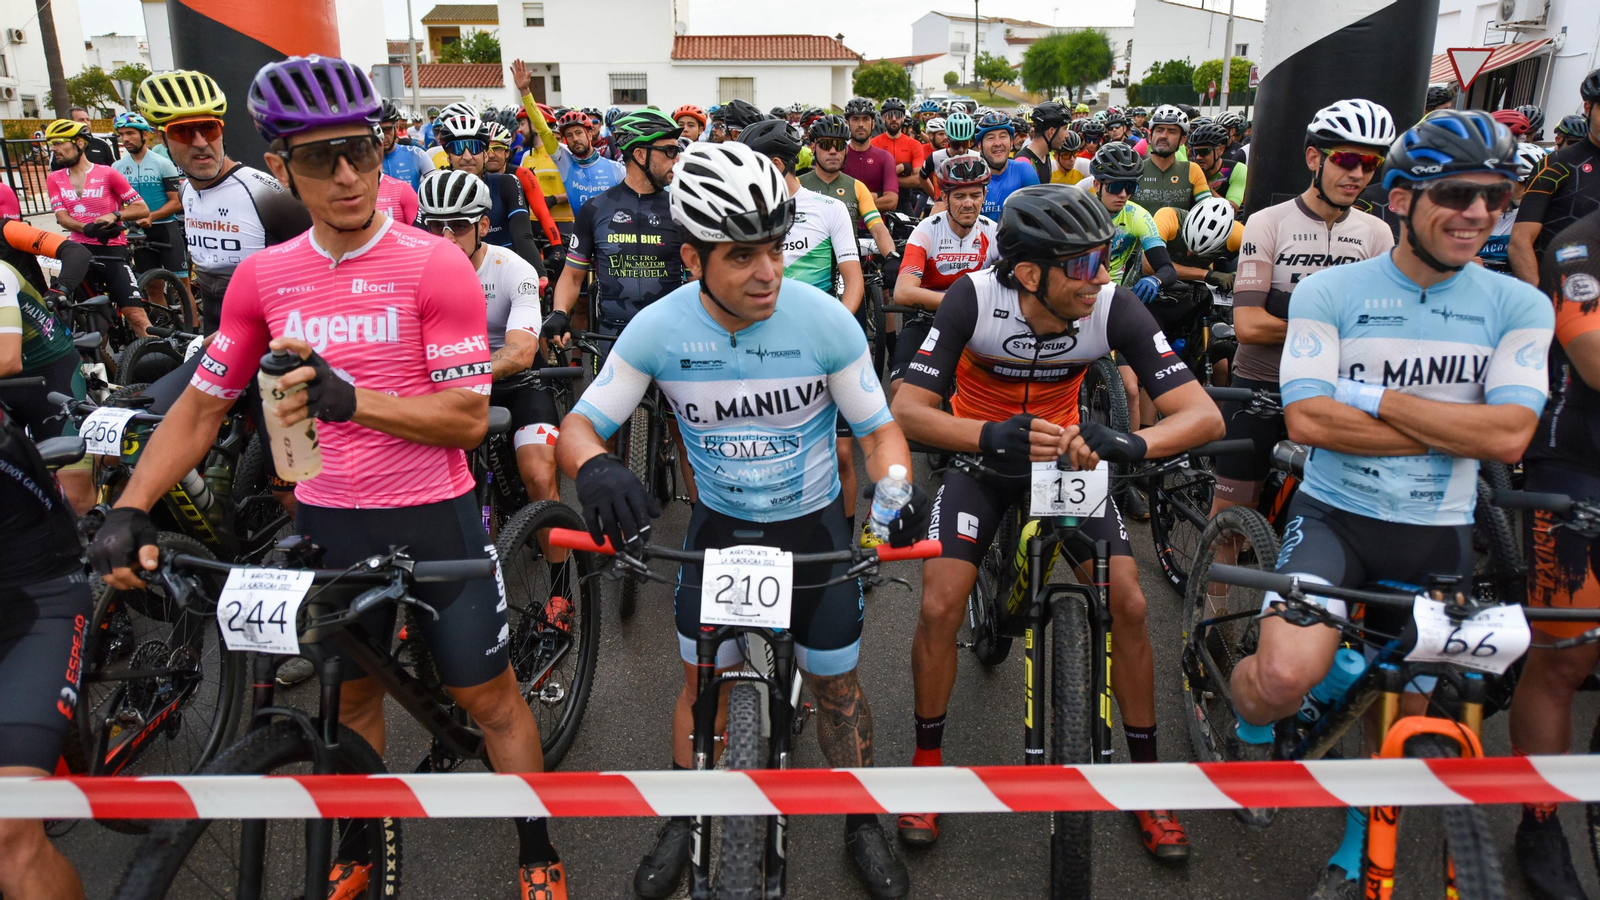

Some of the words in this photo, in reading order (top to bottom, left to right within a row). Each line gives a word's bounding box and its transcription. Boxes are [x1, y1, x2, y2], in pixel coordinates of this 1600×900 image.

[185, 217, 240, 233] Tikismikis
[607, 233, 637, 244] OSUNA
[640, 234, 662, 245] BIKE
[608, 267, 669, 278] LANTEJUELA
[283, 305, 398, 353] Agerul
[1382, 354, 1490, 388] MANILV
[715, 380, 826, 422] MANILVA
[84, 420, 119, 444] 256
[703, 433, 798, 443] instalaciones
[703, 435, 800, 459] ROMAN
[1053, 477, 1087, 504] 13
[715, 574, 781, 608] 210
[226, 600, 288, 635] 244
[65, 614, 86, 685] ESPEJO
[1443, 626, 1498, 658] 66
[131, 699, 180, 751] SCOTT
[382, 816, 397, 896] MAXXIS
